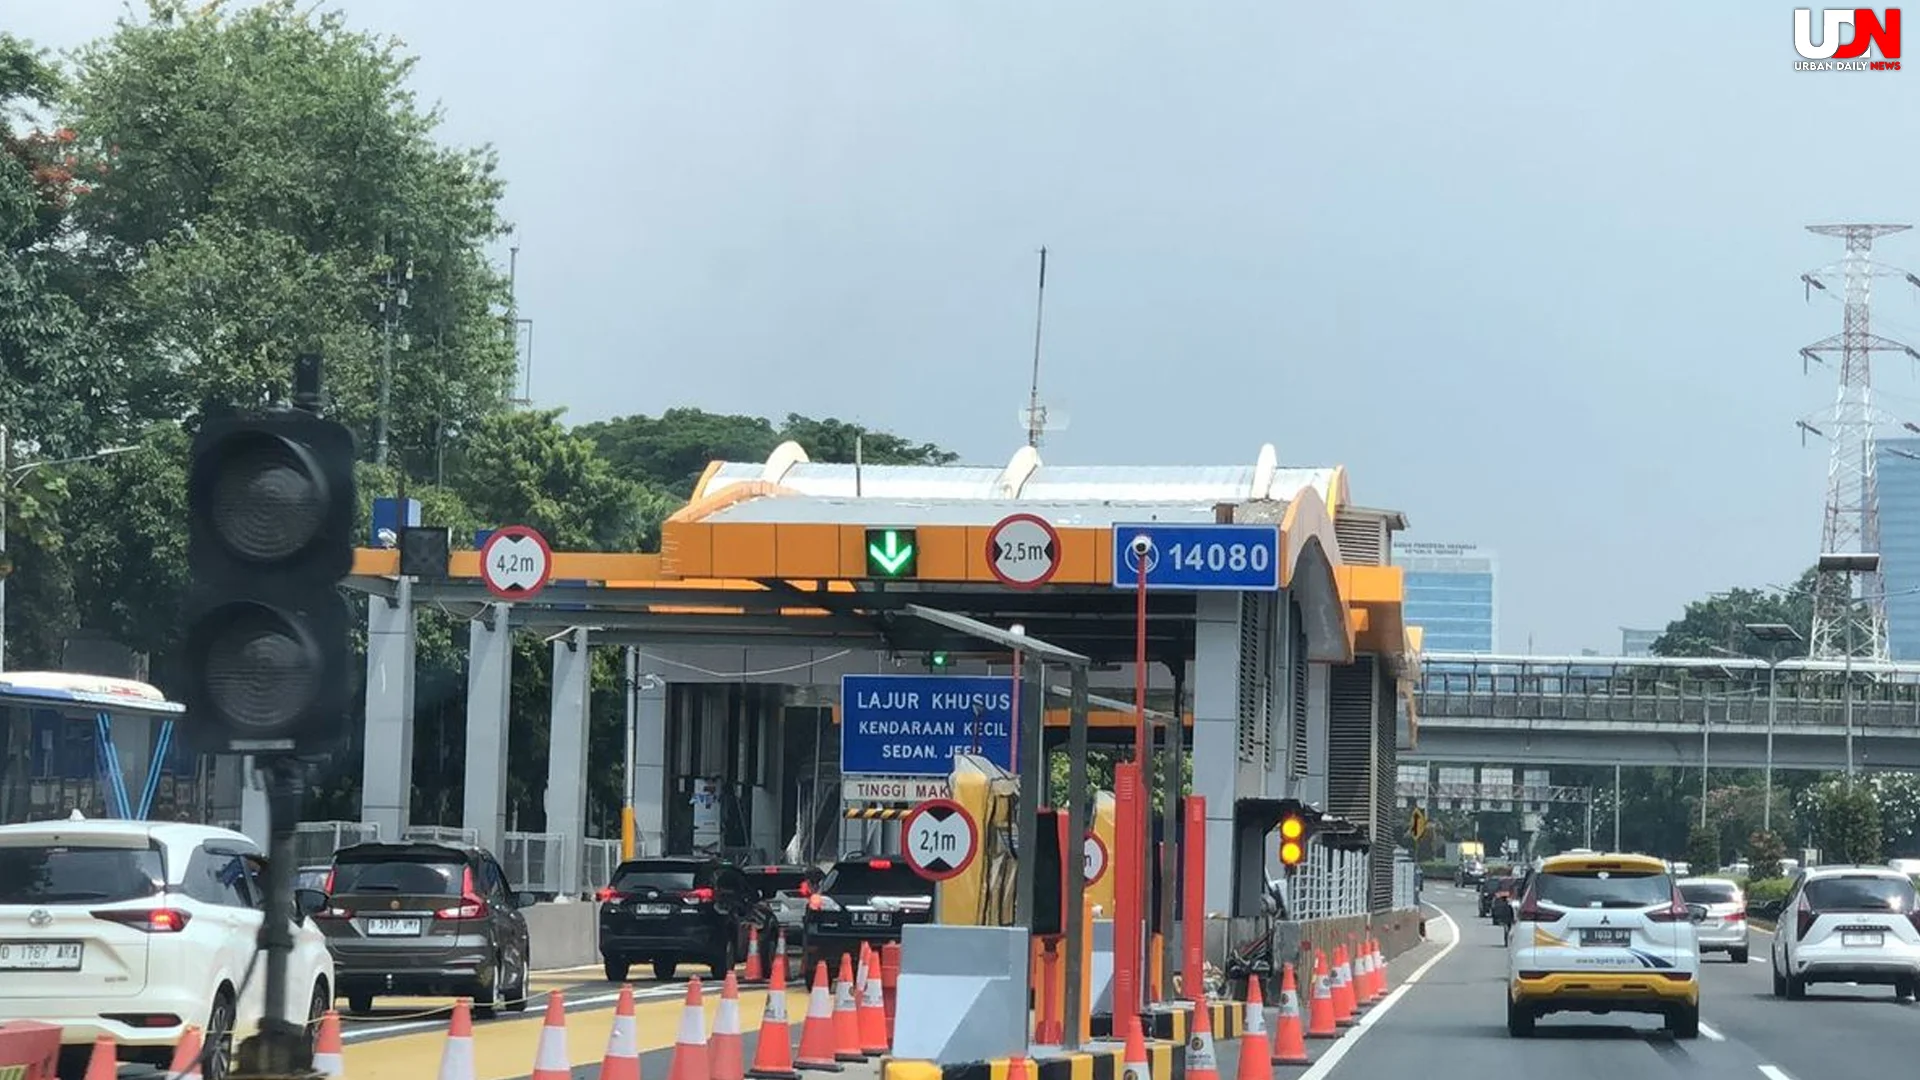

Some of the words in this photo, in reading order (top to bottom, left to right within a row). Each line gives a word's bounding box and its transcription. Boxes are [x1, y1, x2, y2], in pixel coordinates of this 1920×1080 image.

[1168, 543, 1269, 571] 14080
[857, 691, 919, 710] LAJUR
[931, 692, 1010, 710] KHUSUS
[859, 721, 955, 736] KENDARAAN
[964, 721, 1008, 737] KECIL
[857, 783, 906, 798] TINGGI
[915, 784, 949, 798] MAK
[920, 829, 956, 853] 2,1m
